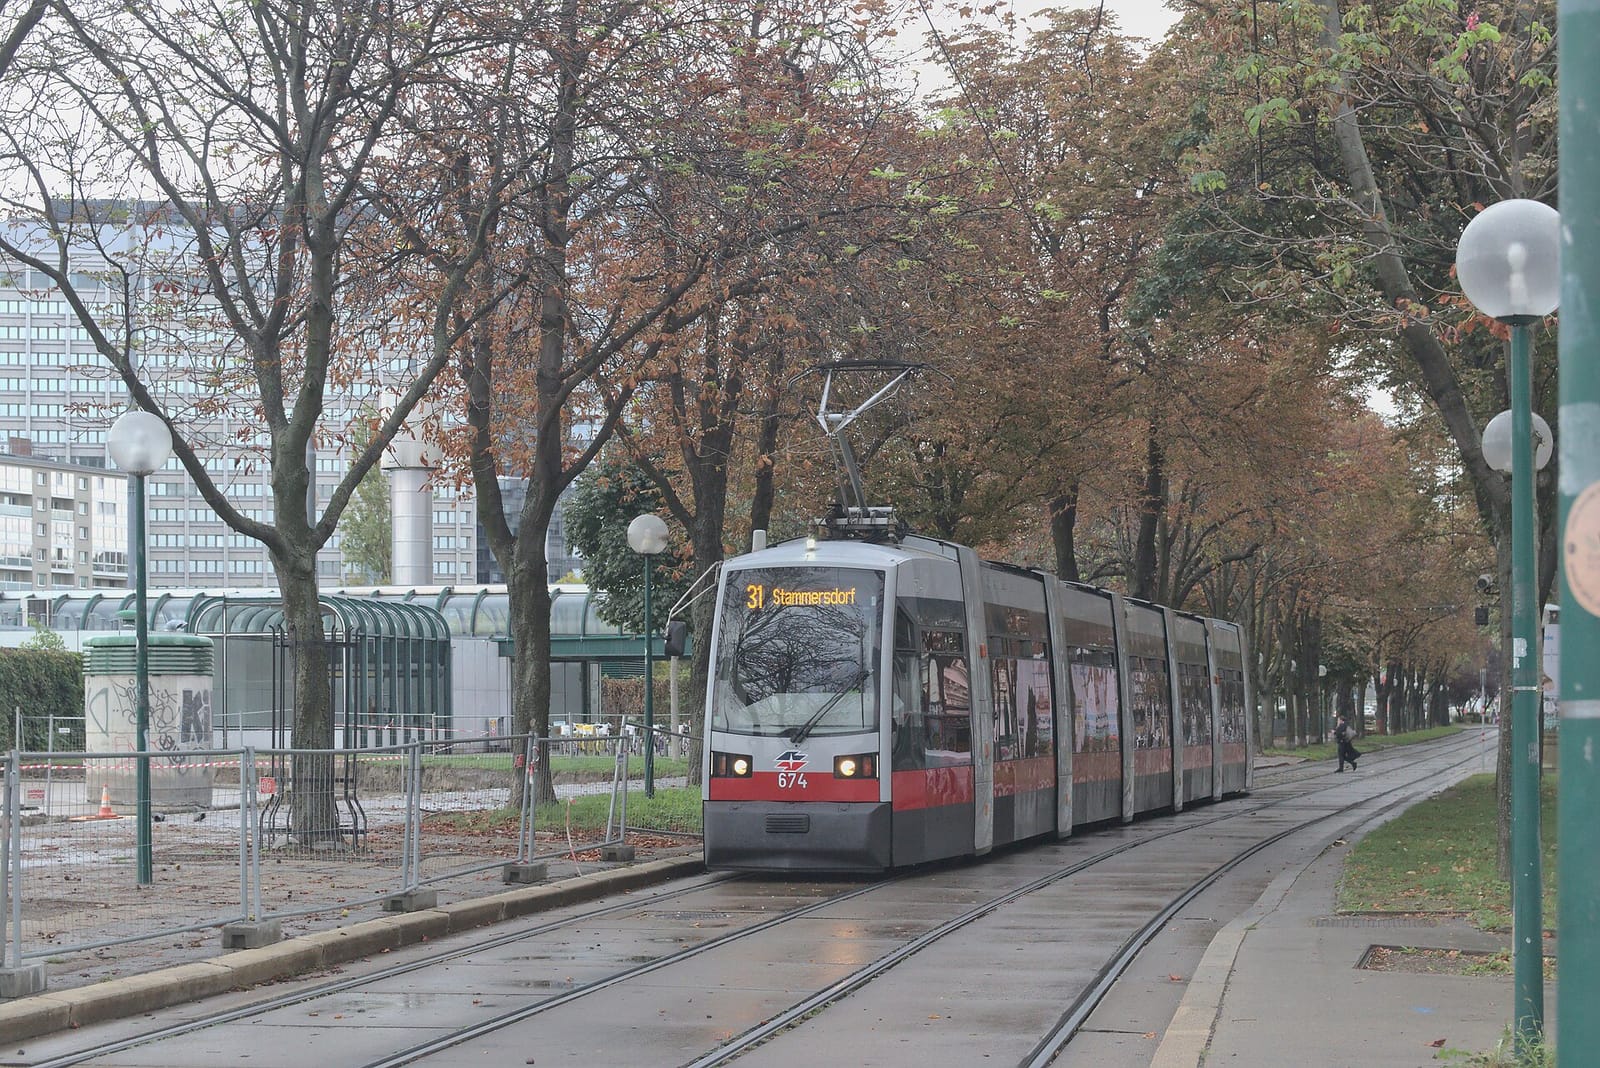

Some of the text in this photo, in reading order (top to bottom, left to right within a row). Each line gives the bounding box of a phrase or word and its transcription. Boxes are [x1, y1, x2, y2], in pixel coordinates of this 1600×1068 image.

[747, 584, 856, 609] 31 Stammersdorf
[778, 772, 808, 789] 674
